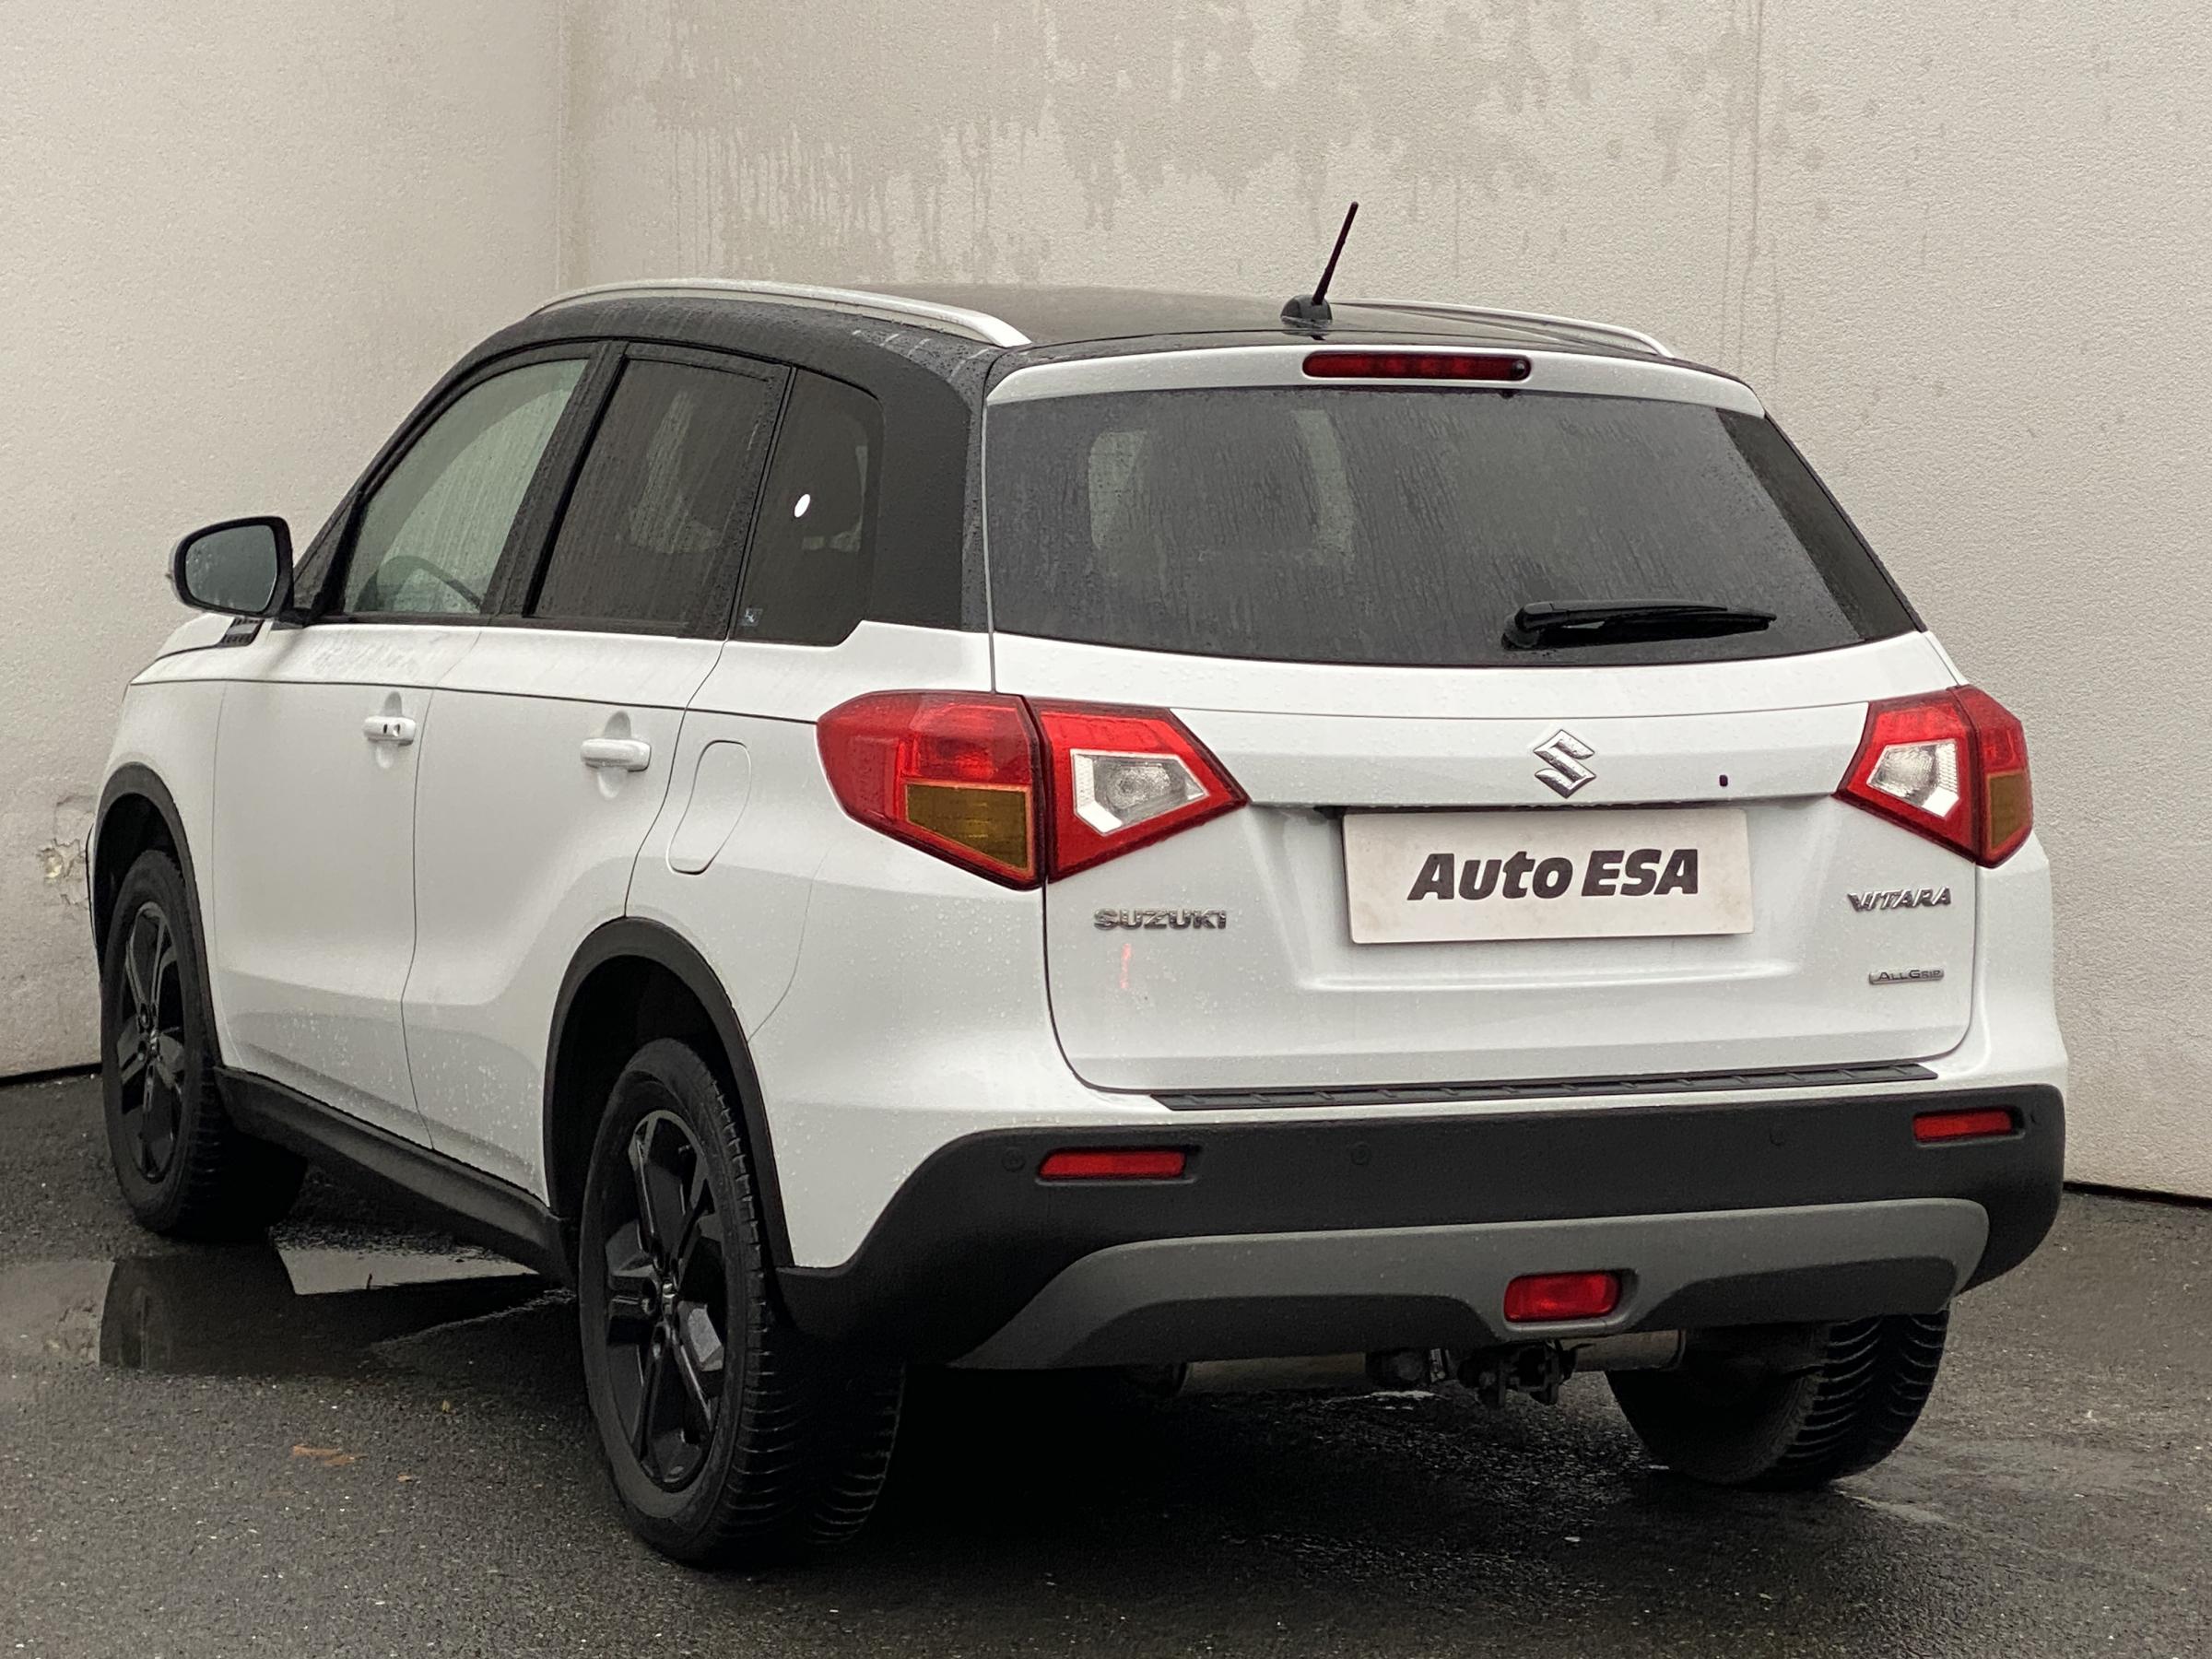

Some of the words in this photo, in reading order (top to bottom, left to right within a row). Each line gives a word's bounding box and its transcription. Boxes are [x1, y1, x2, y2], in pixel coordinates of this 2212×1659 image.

[1406, 851, 1573, 900] Auto
[1581, 849, 1699, 897] ESA
[1847, 887, 1951, 912] VITARA
[1093, 908, 1227, 930] SUZUKI
